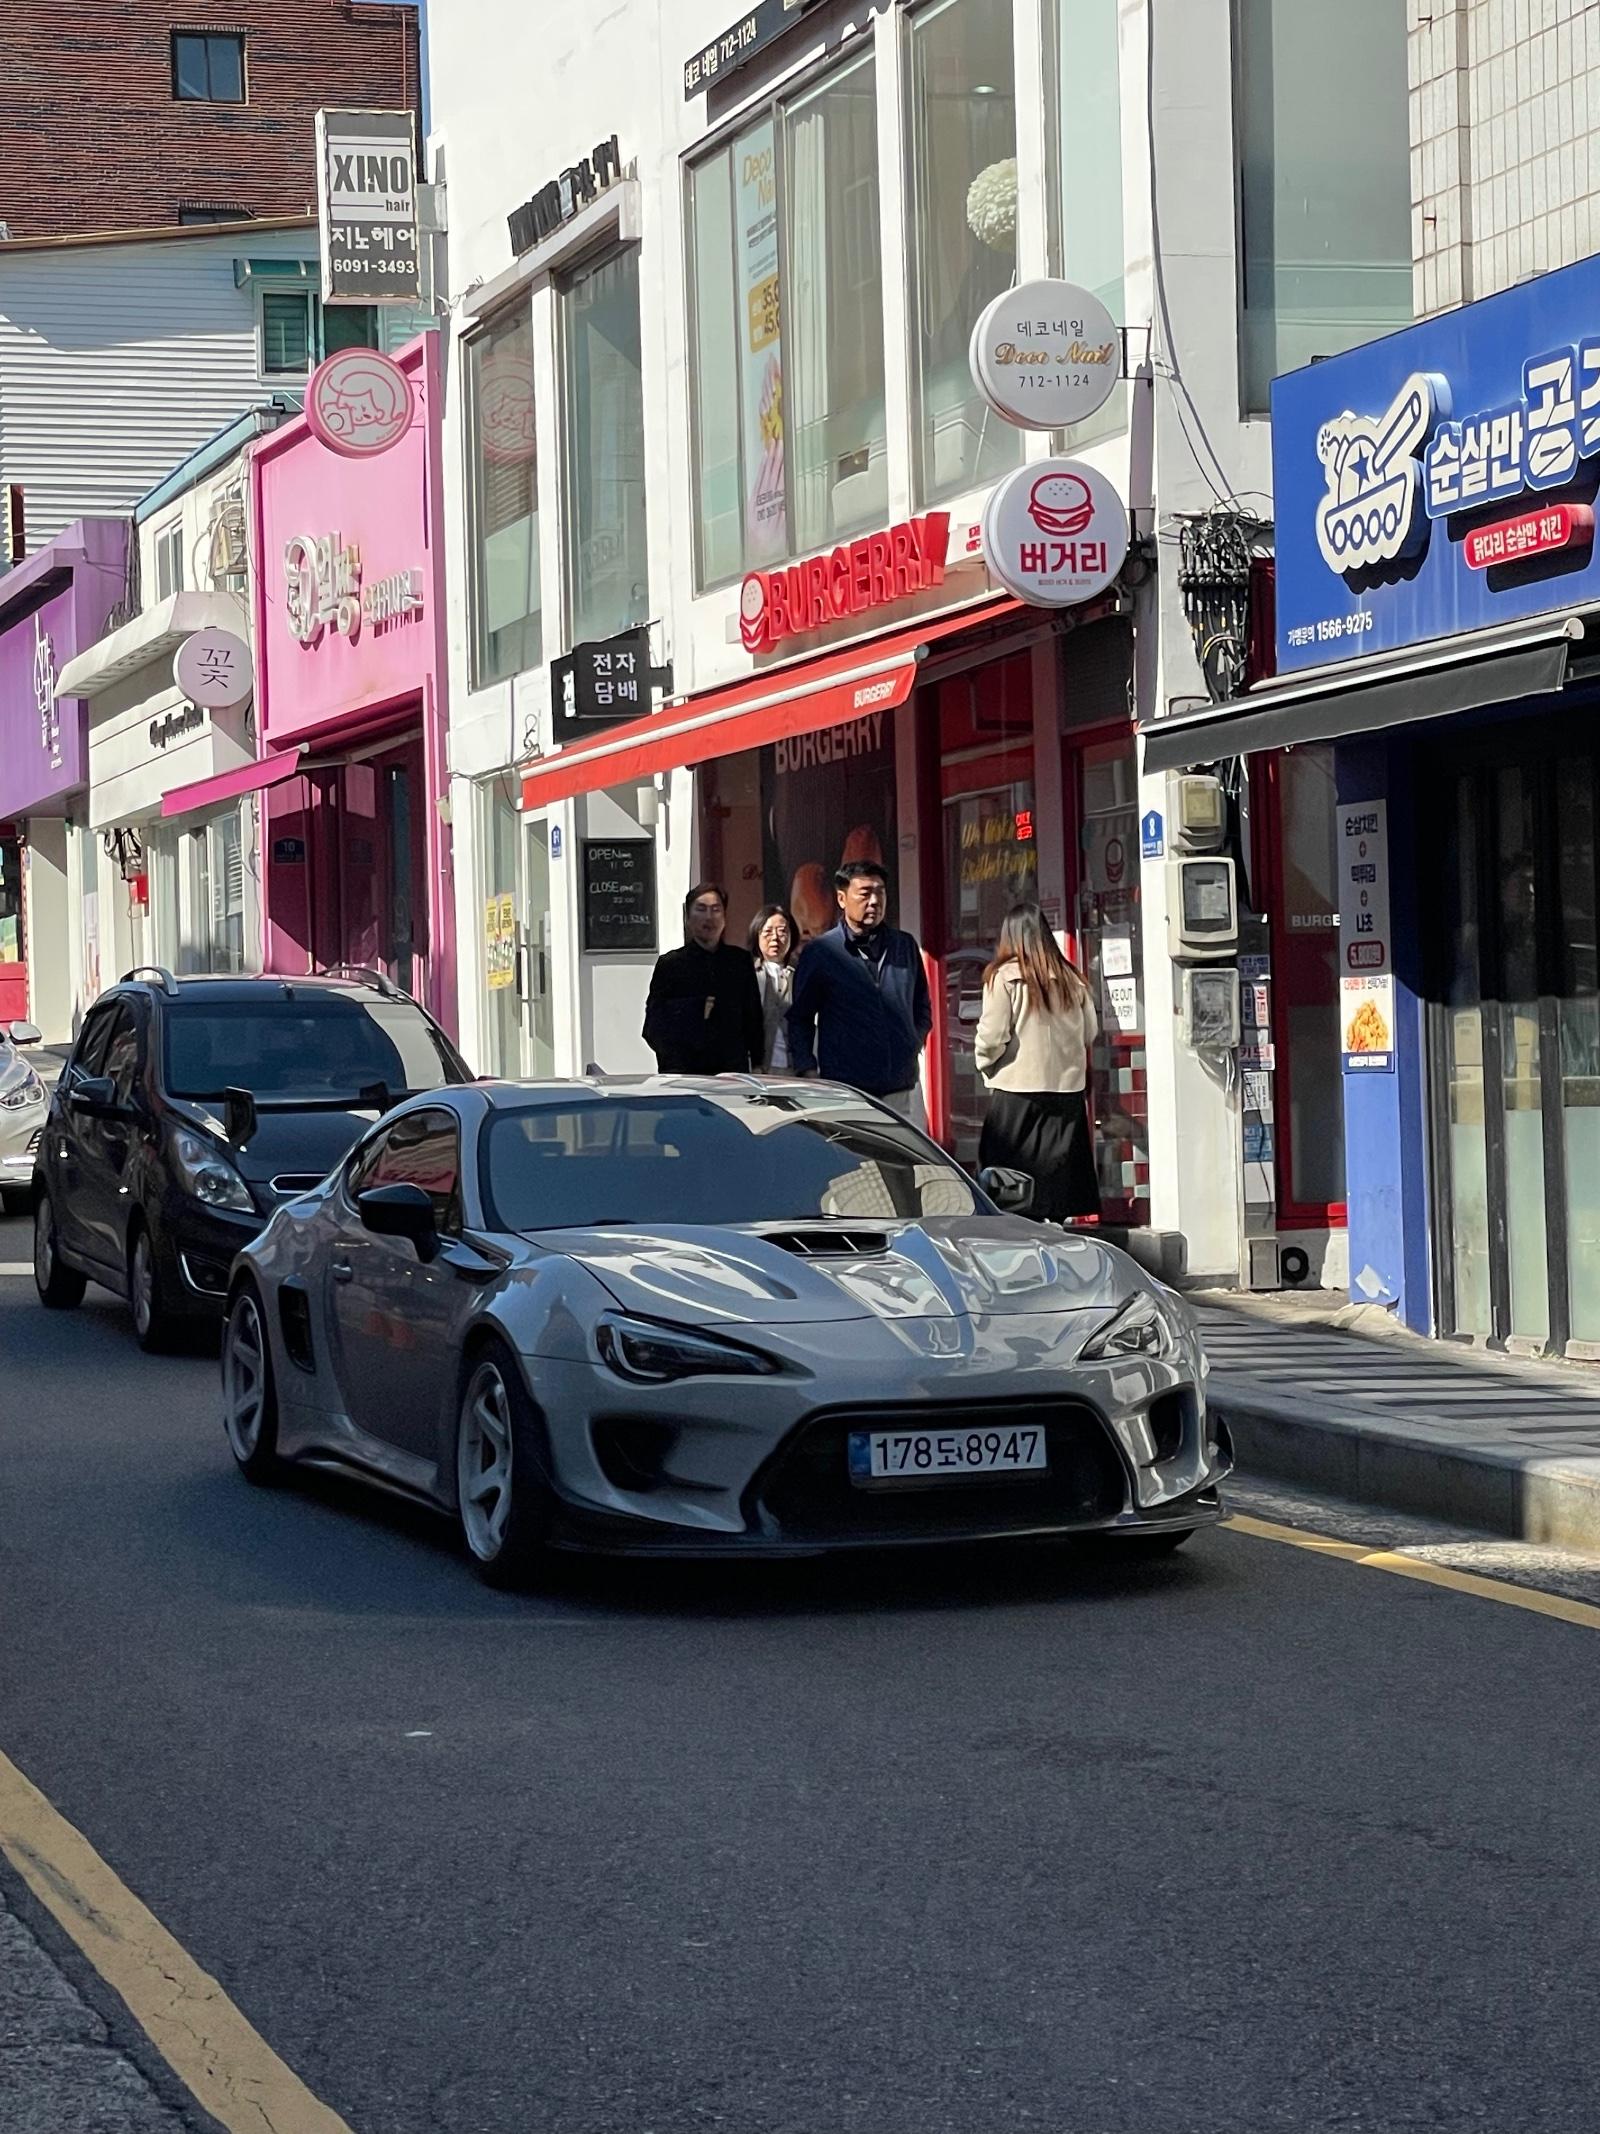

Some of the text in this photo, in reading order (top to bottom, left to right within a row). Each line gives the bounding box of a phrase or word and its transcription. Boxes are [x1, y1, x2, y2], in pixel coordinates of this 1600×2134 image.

[720, 17, 757, 62] 712-1124
[333, 154, 410, 194] XINO
[385, 199, 411, 212] hair
[331, 227, 416, 251] 지노헤어
[333, 258, 416, 274] 6091-3493
[1016, 320, 1085, 337] 데코네일
[1018, 374, 1091, 388] 712-1124
[1473, 513, 1563, 562] 닭다리 순살만 치킨
[1020, 542, 1108, 574] 버거리
[767, 511, 951, 641] BURGERRY
[1316, 610, 1373, 641] 1566-9275
[196, 647, 234, 688] 꽃
[592, 651, 637, 676] 전자
[594, 680, 638, 704] 담배
[853, 679, 897, 708] BURGERRY
[1149, 817, 1156, 837] 8
[589, 848, 621, 861] OPEN
[590, 881, 619, 894] CLOSE
